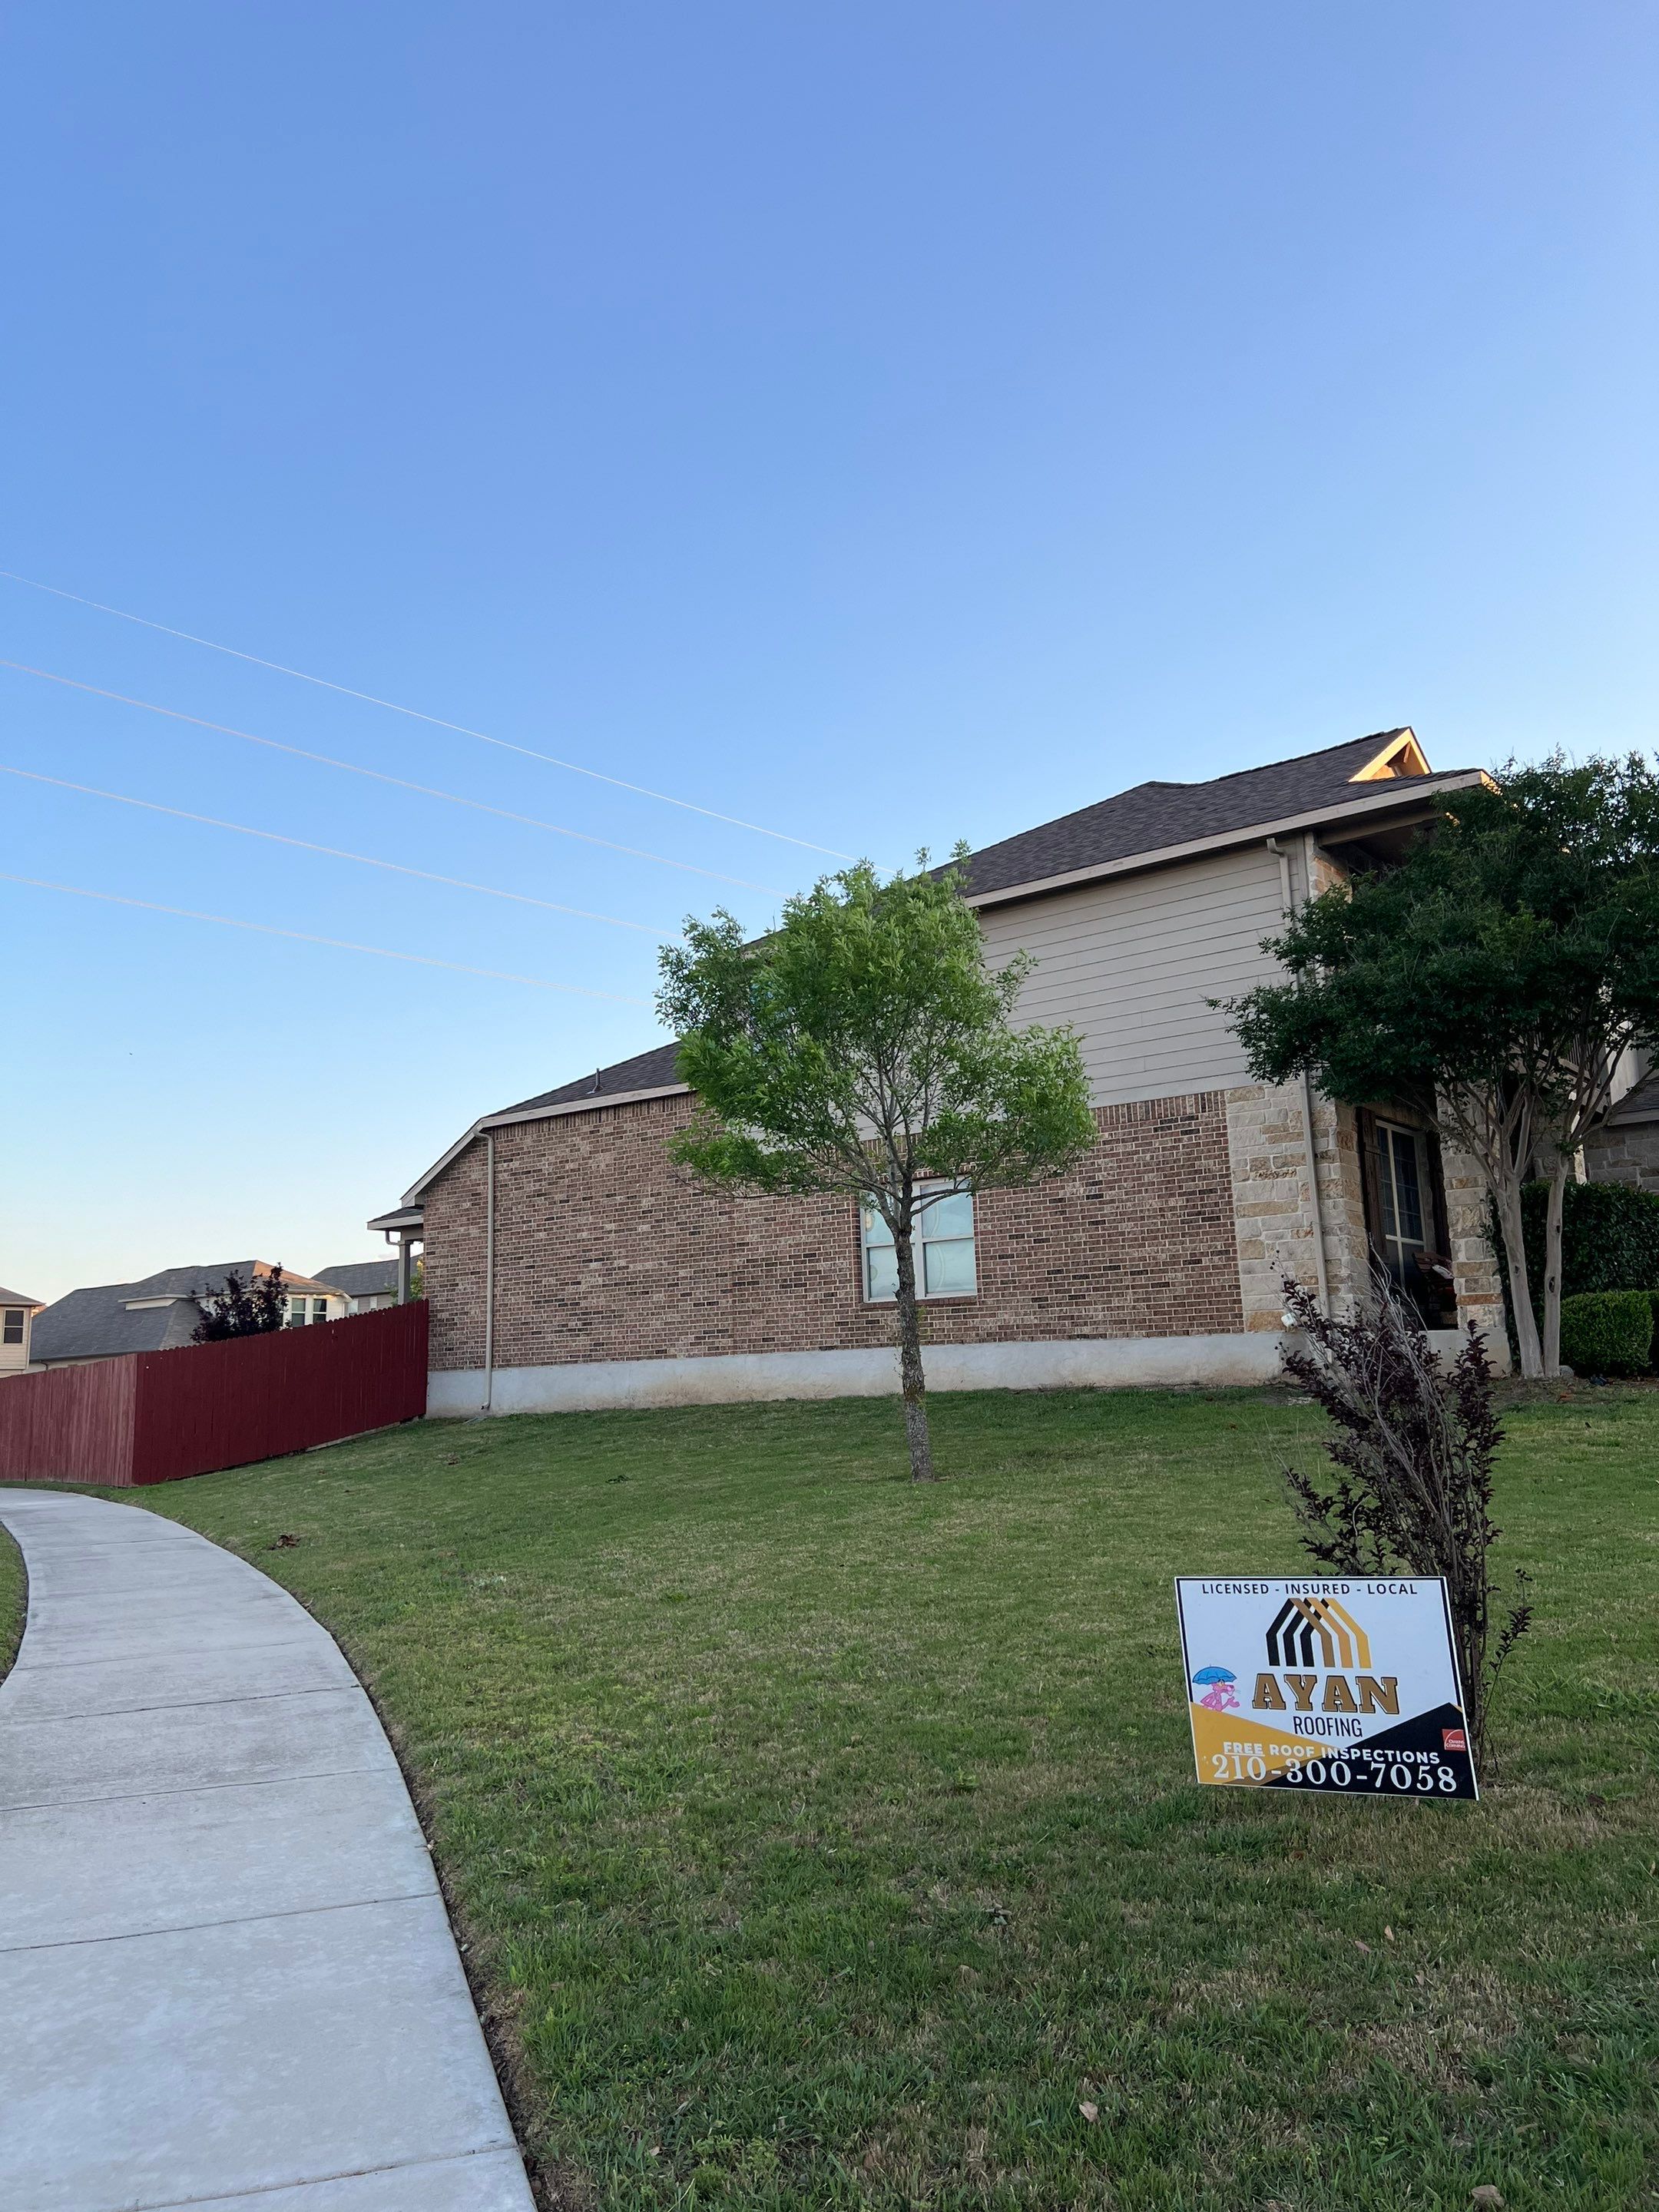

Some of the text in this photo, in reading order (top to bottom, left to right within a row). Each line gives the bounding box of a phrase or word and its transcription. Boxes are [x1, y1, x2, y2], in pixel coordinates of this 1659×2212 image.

[1202, 1584, 1269, 1594] LICENSED
[1285, 1584, 1350, 1594] INSURED
[1367, 1584, 1418, 1594] LOCAL
[1252, 1673, 1399, 1714] AYAN
[1293, 1716, 1363, 1737] ROOFING
[1223, 1741, 1440, 1764] FREE ROOF INSPECTIONS
[1212, 1754, 1457, 1792] 210-300-7058
